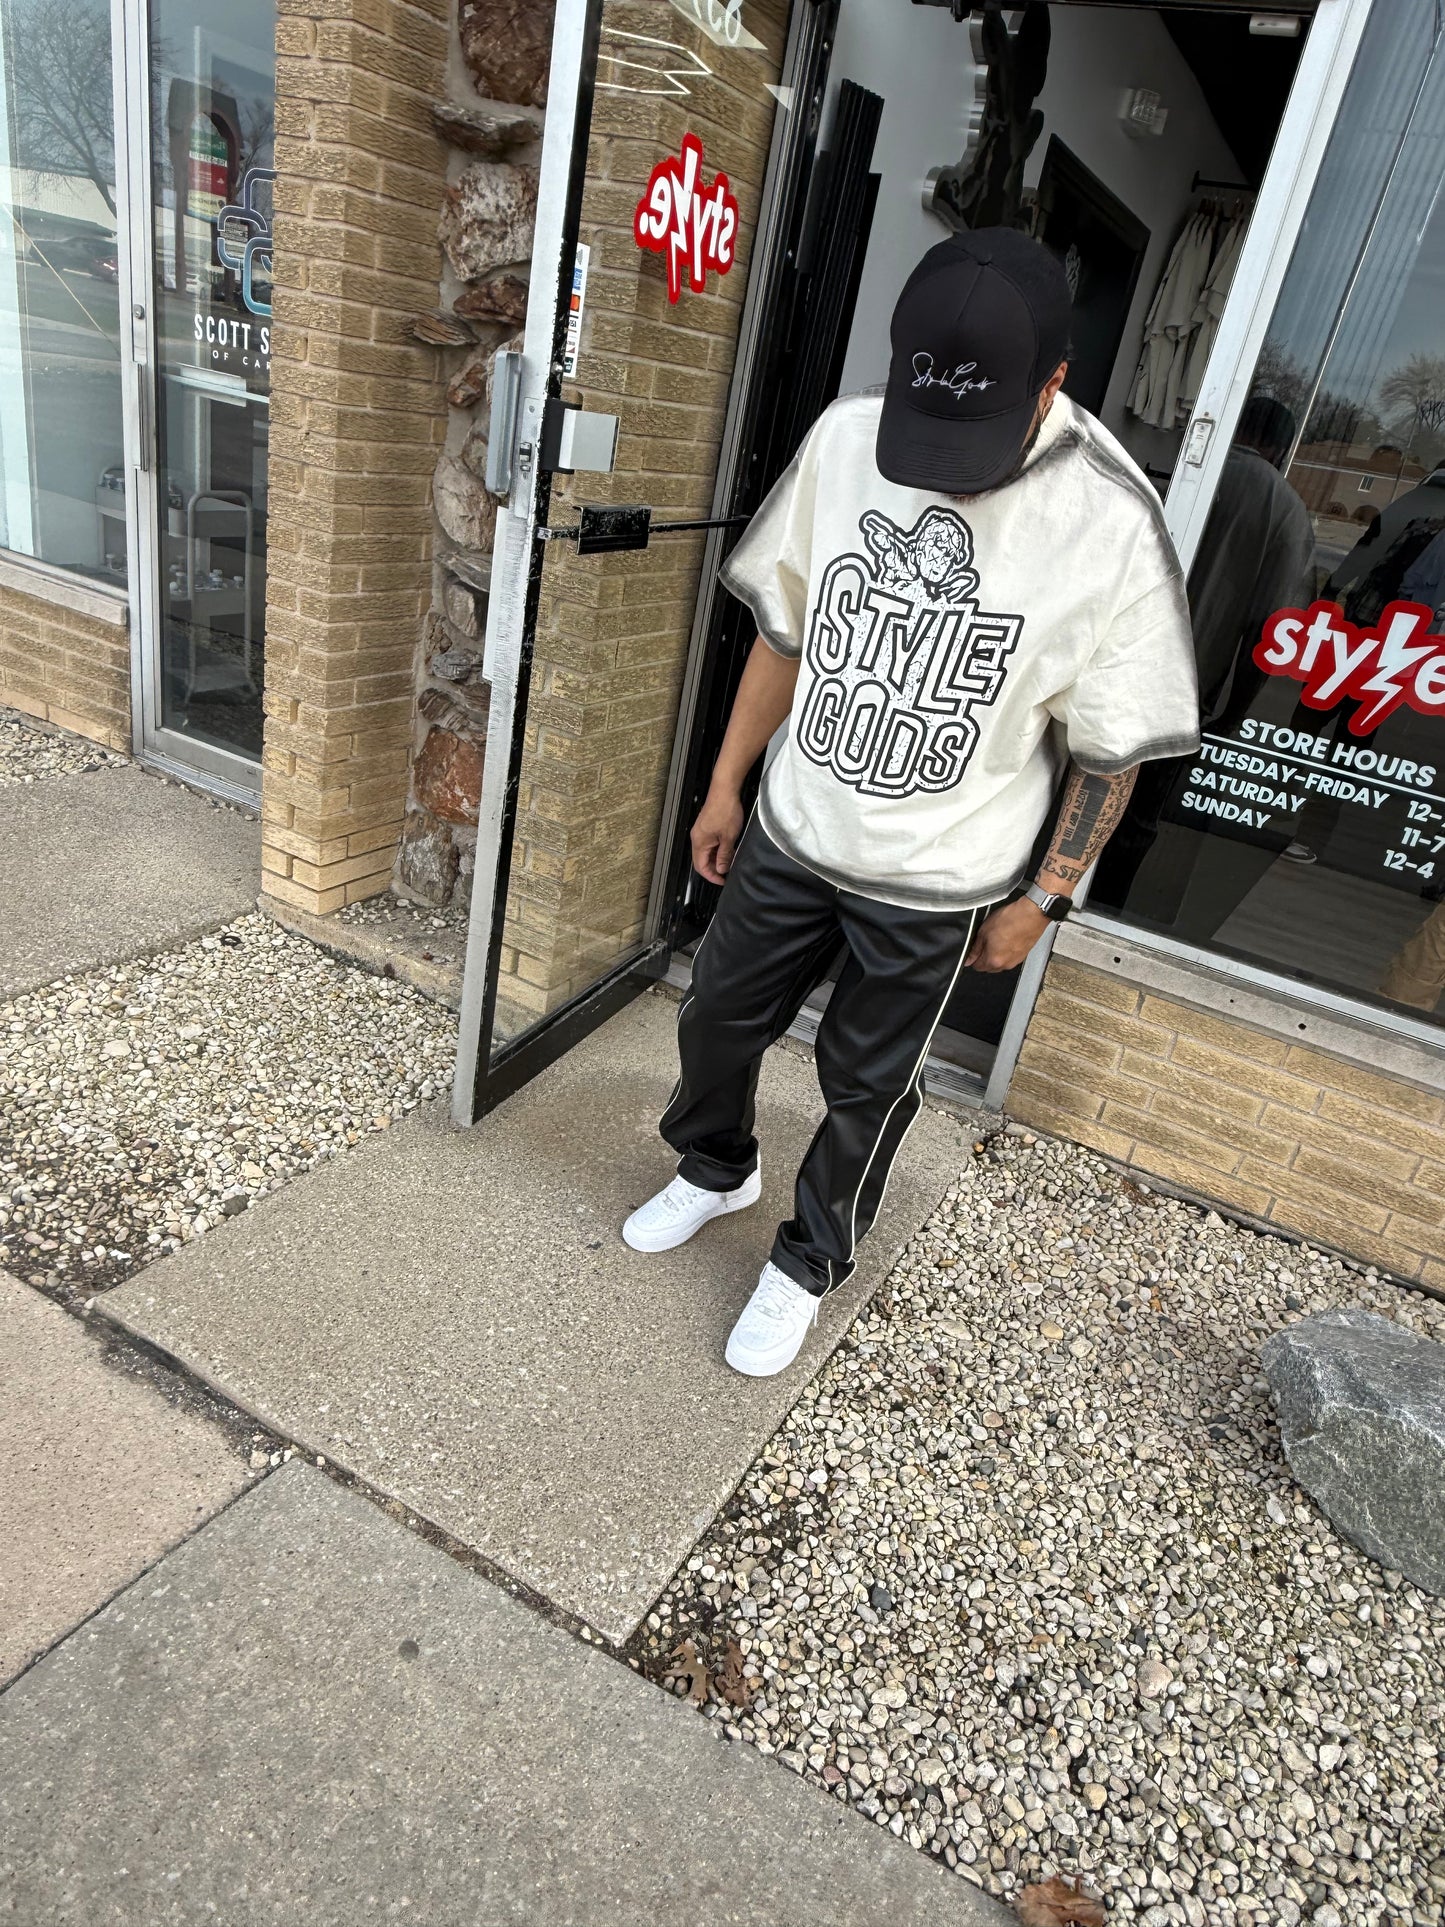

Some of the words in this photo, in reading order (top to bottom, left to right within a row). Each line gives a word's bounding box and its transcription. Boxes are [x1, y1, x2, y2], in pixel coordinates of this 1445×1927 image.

[194, 313, 251, 351] SCOTT
[212, 350, 230, 361] OF
[808, 555, 1025, 717] STYLE
[799, 677, 981, 798] GODS
[1239, 718, 1336, 760] STORE
[1331, 744, 1437, 788] HOURS
[1189, 767, 1307, 814] SATURDAY
[1401, 826, 1445, 854] 11-7
[1199, 743, 1391, 809] TUESDAY-FRIDAY
[1407, 800, 1445, 828] 12-
[1181, 791, 1271, 830] SUNDAY
[1383, 849, 1436, 879] 12-4
